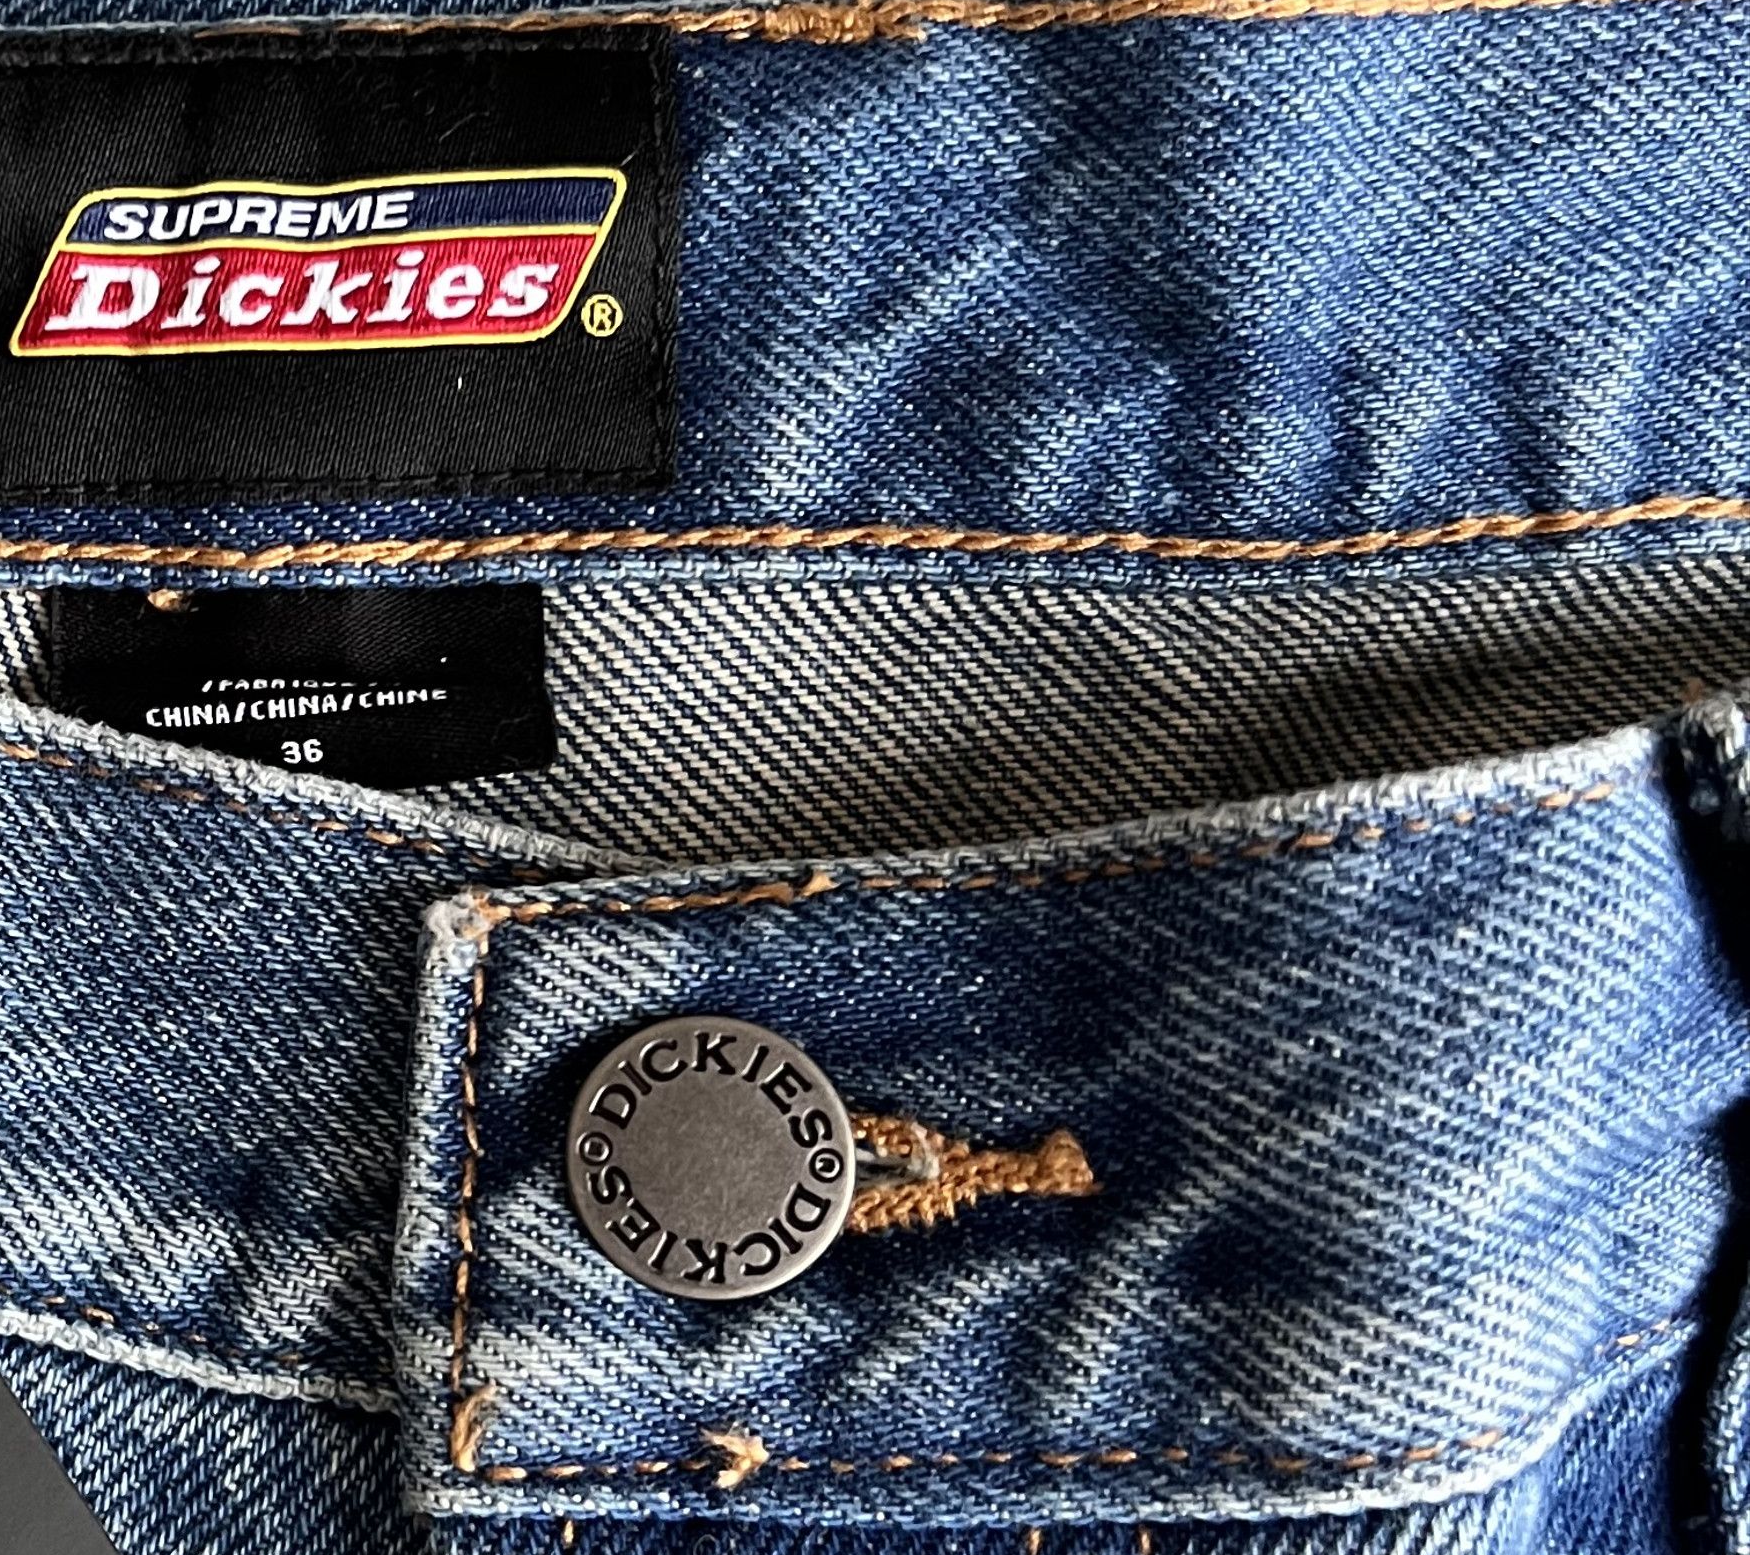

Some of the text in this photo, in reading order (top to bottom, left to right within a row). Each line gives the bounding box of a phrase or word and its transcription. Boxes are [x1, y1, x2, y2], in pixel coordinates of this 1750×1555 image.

[103, 190, 415, 241] SUPREME
[44, 251, 561, 332] Dickies
[280, 738, 325, 765] 36
[588, 1030, 833, 1149] DICKIES
[585, 1165, 832, 1284] DICKIES
